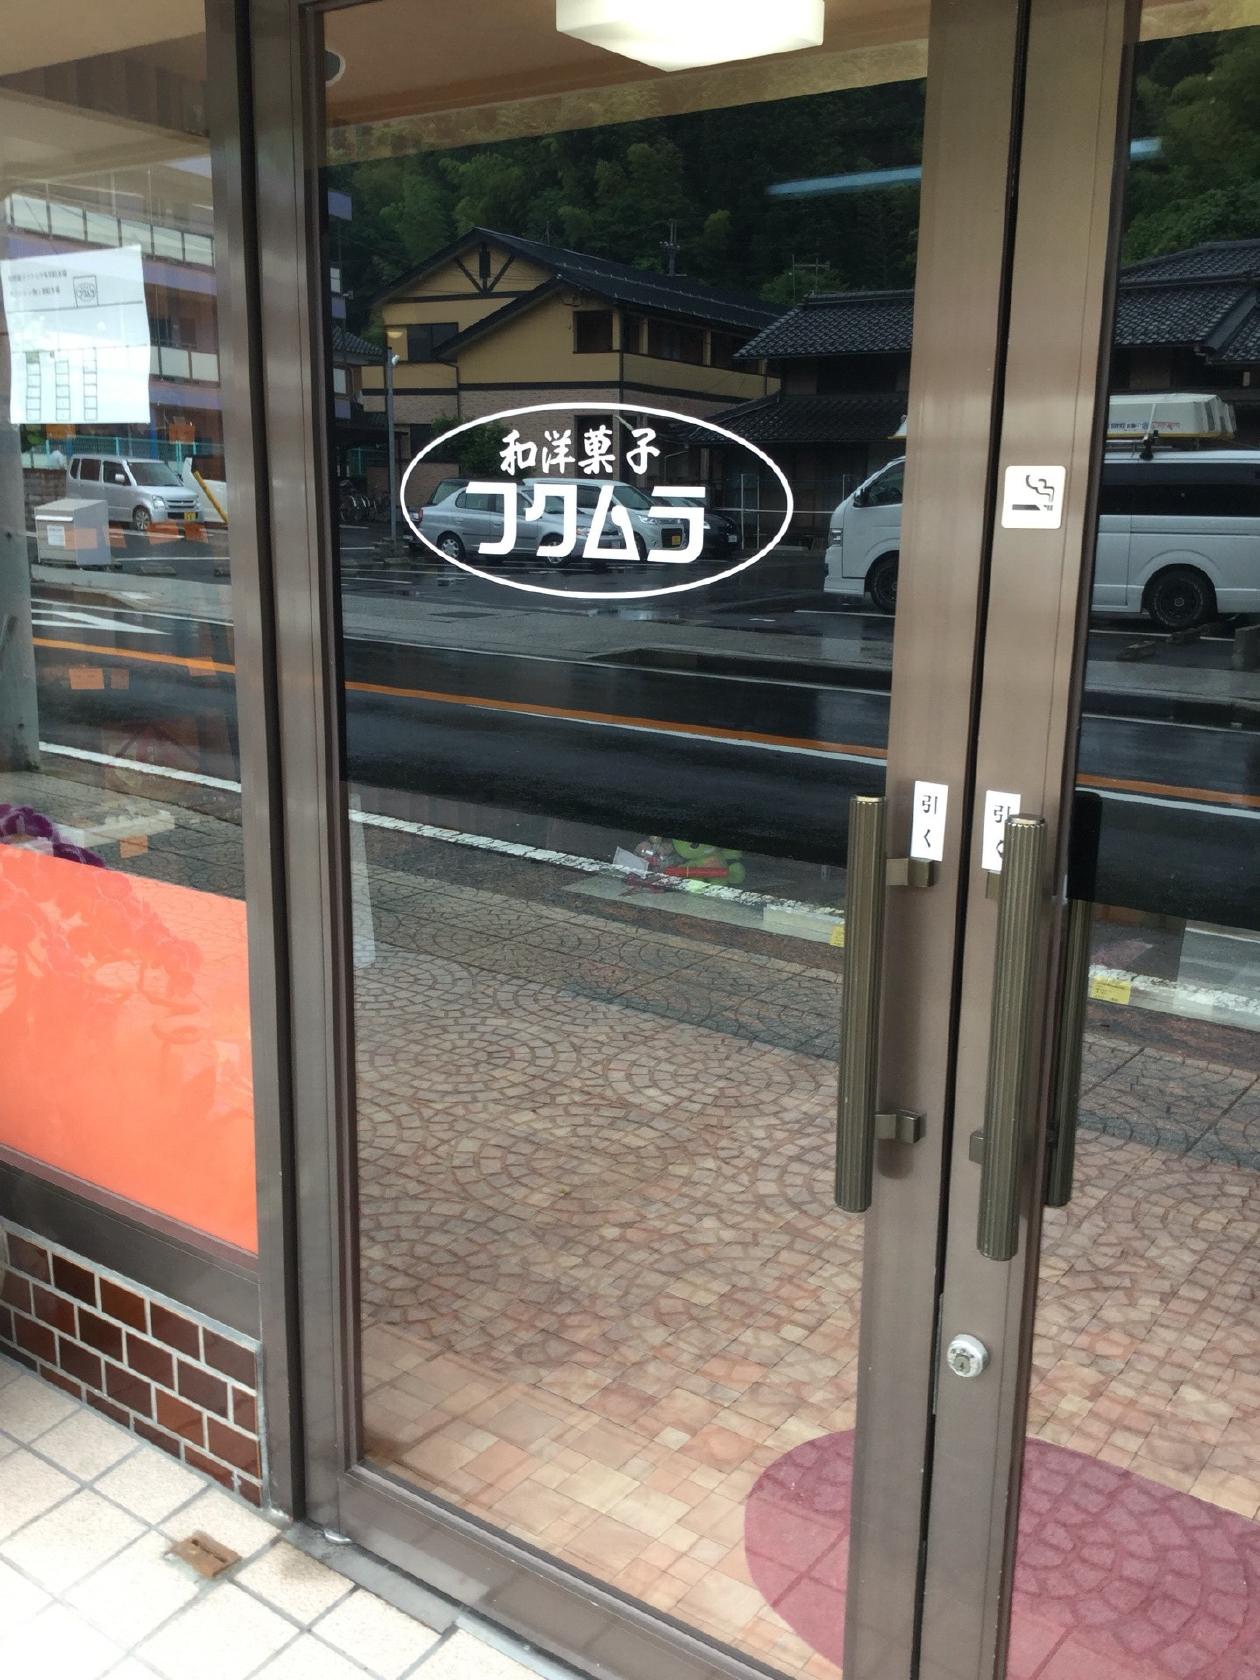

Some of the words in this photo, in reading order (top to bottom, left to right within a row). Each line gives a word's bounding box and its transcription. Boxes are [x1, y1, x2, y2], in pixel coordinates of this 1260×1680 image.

[499, 424, 661, 476] 和洋菓子
[465, 481, 706, 563] フクムラ
[921, 795, 938, 848] 引く
